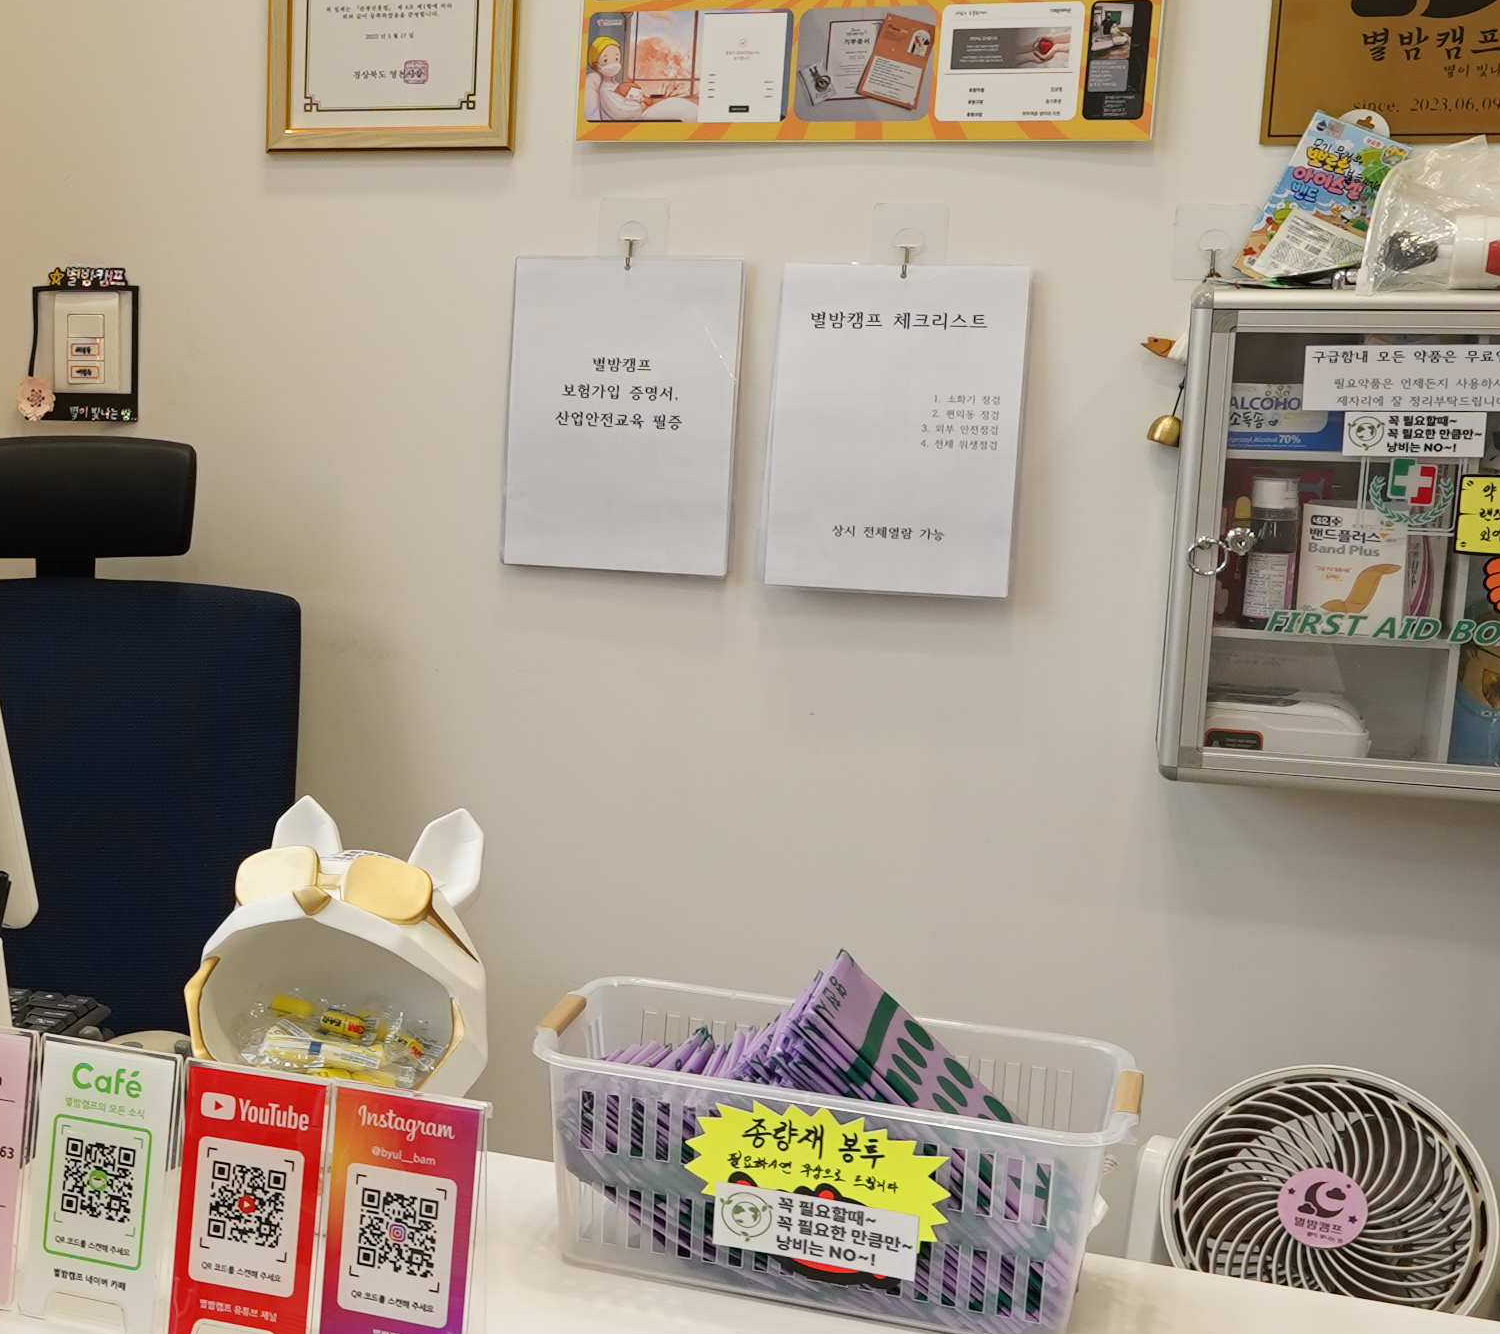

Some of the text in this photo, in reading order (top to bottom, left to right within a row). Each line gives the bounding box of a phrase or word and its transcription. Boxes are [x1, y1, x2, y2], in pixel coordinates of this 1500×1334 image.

[1443, 63, 1471, 78] 별이
[1353, 98, 1400, 114] since.
[810, 311, 988, 331] 별밤캠프 체크리스트
[592, 356, 652, 373] 별밤캠프
[1311, 349, 1369, 365] 구급함내
[1376, 350, 1405, 364] 모든
[1414, 350, 1457, 364] 약품은
[561, 383, 621, 401] 보험가입
[1334, 378, 1394, 390] 필요약품은
[1401, 377, 1448, 389] 언제든지
[554, 410, 683, 431] 산업안전교육 필증
[1278, 434, 1301, 444] 70%
[1482, 485, 1498, 501] 약
[1309, 526, 1381, 544] 밴드플러스
[1308, 542, 1380, 558] Band Plus
[1264, 610, 1369, 637] FIRST
[1372, 615, 1443, 642] AID
[72, 1062, 143, 1099] Café
[238, 1098, 310, 1131] YouTube
[357, 1104, 456, 1141] Instagram
[838, 1132, 886, 1169] 봉투
[777, 1194, 794, 1214] 꼭
[776, 1214, 793, 1233] 꼭
[797, 1216, 846, 1243] 필요한
[775, 1233, 825, 1259] 낭비는
[53, 1268, 126, 1291] 별밤캠프 네이버 카페
[201, 1261, 282, 1283] QR 코드를 스캔해 주세요
